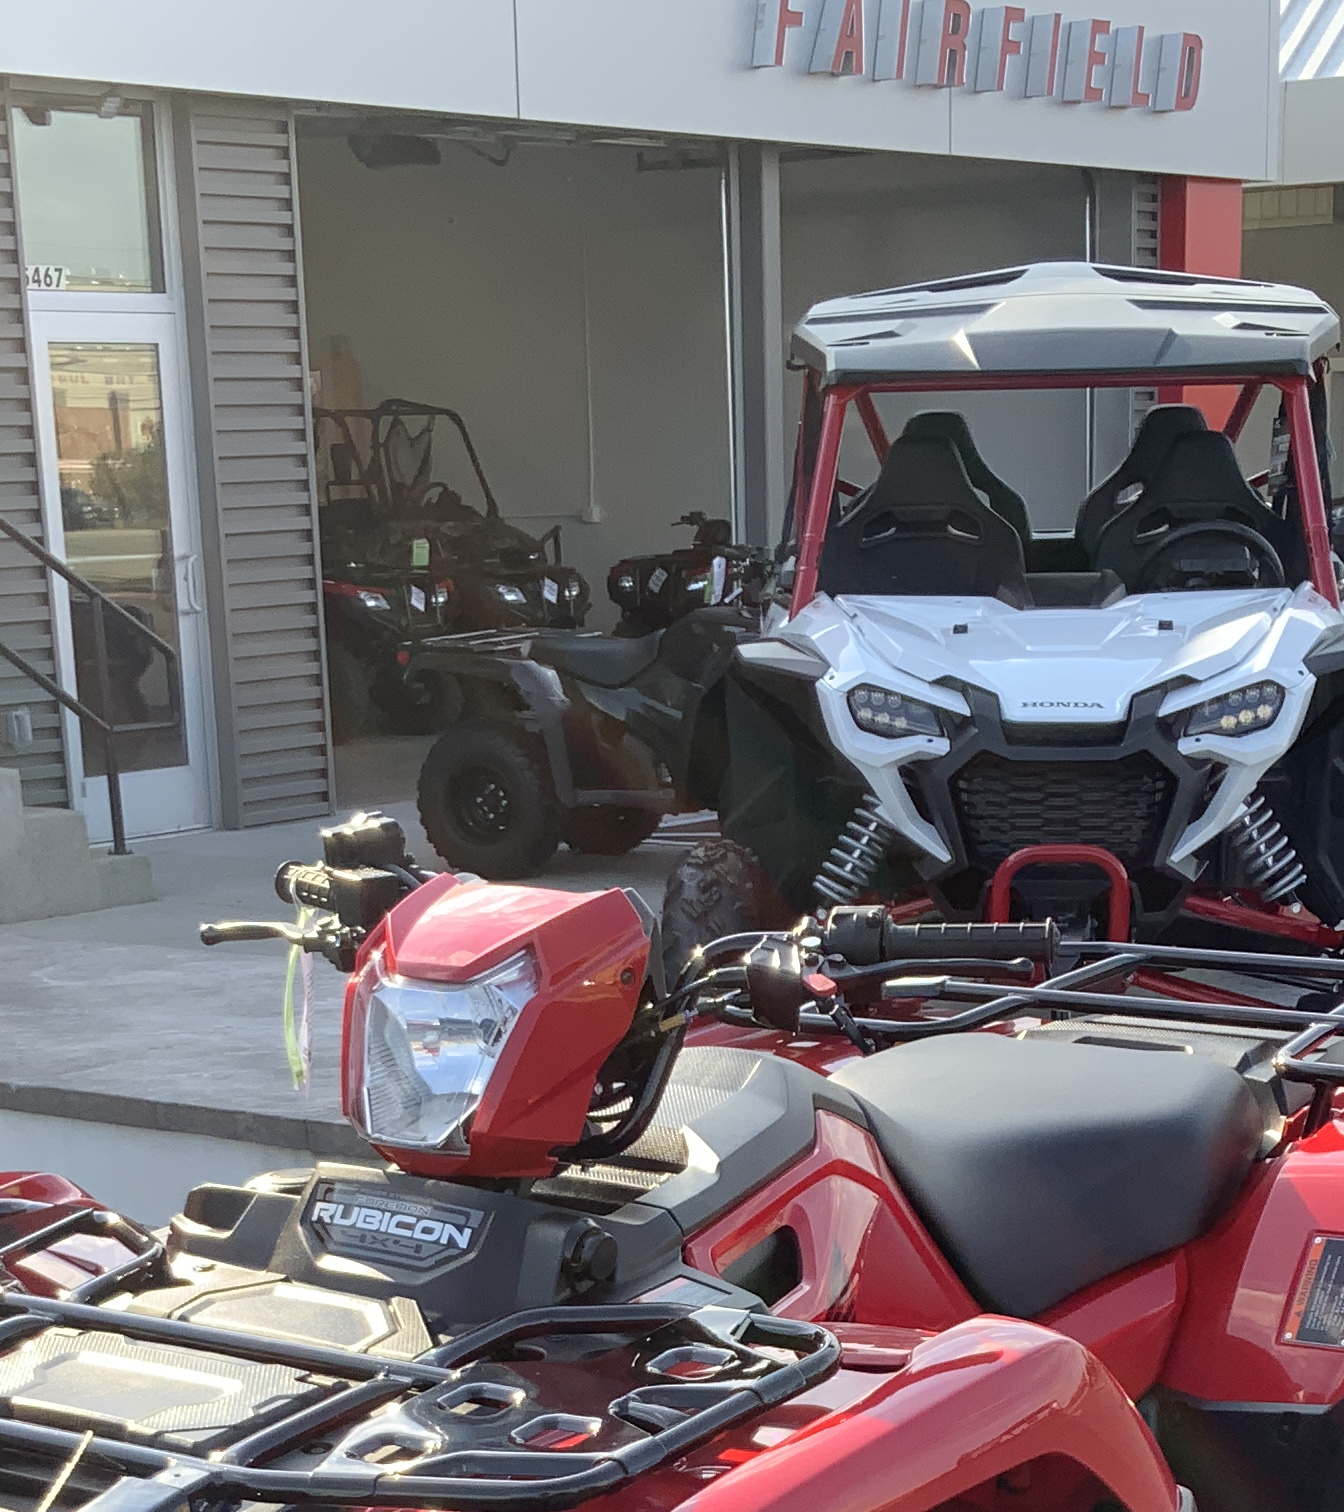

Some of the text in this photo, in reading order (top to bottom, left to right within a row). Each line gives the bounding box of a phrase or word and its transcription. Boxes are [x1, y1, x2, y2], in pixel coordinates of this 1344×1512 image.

[753, 0, 1204, 112] FAIRFIELD
[1021, 701, 1105, 709] HONDA
[311, 1201, 473, 1250] RUBICON
[356, 1195, 431, 1216] FOREMAN
[1296, 1258, 1318, 1306] WARNING
